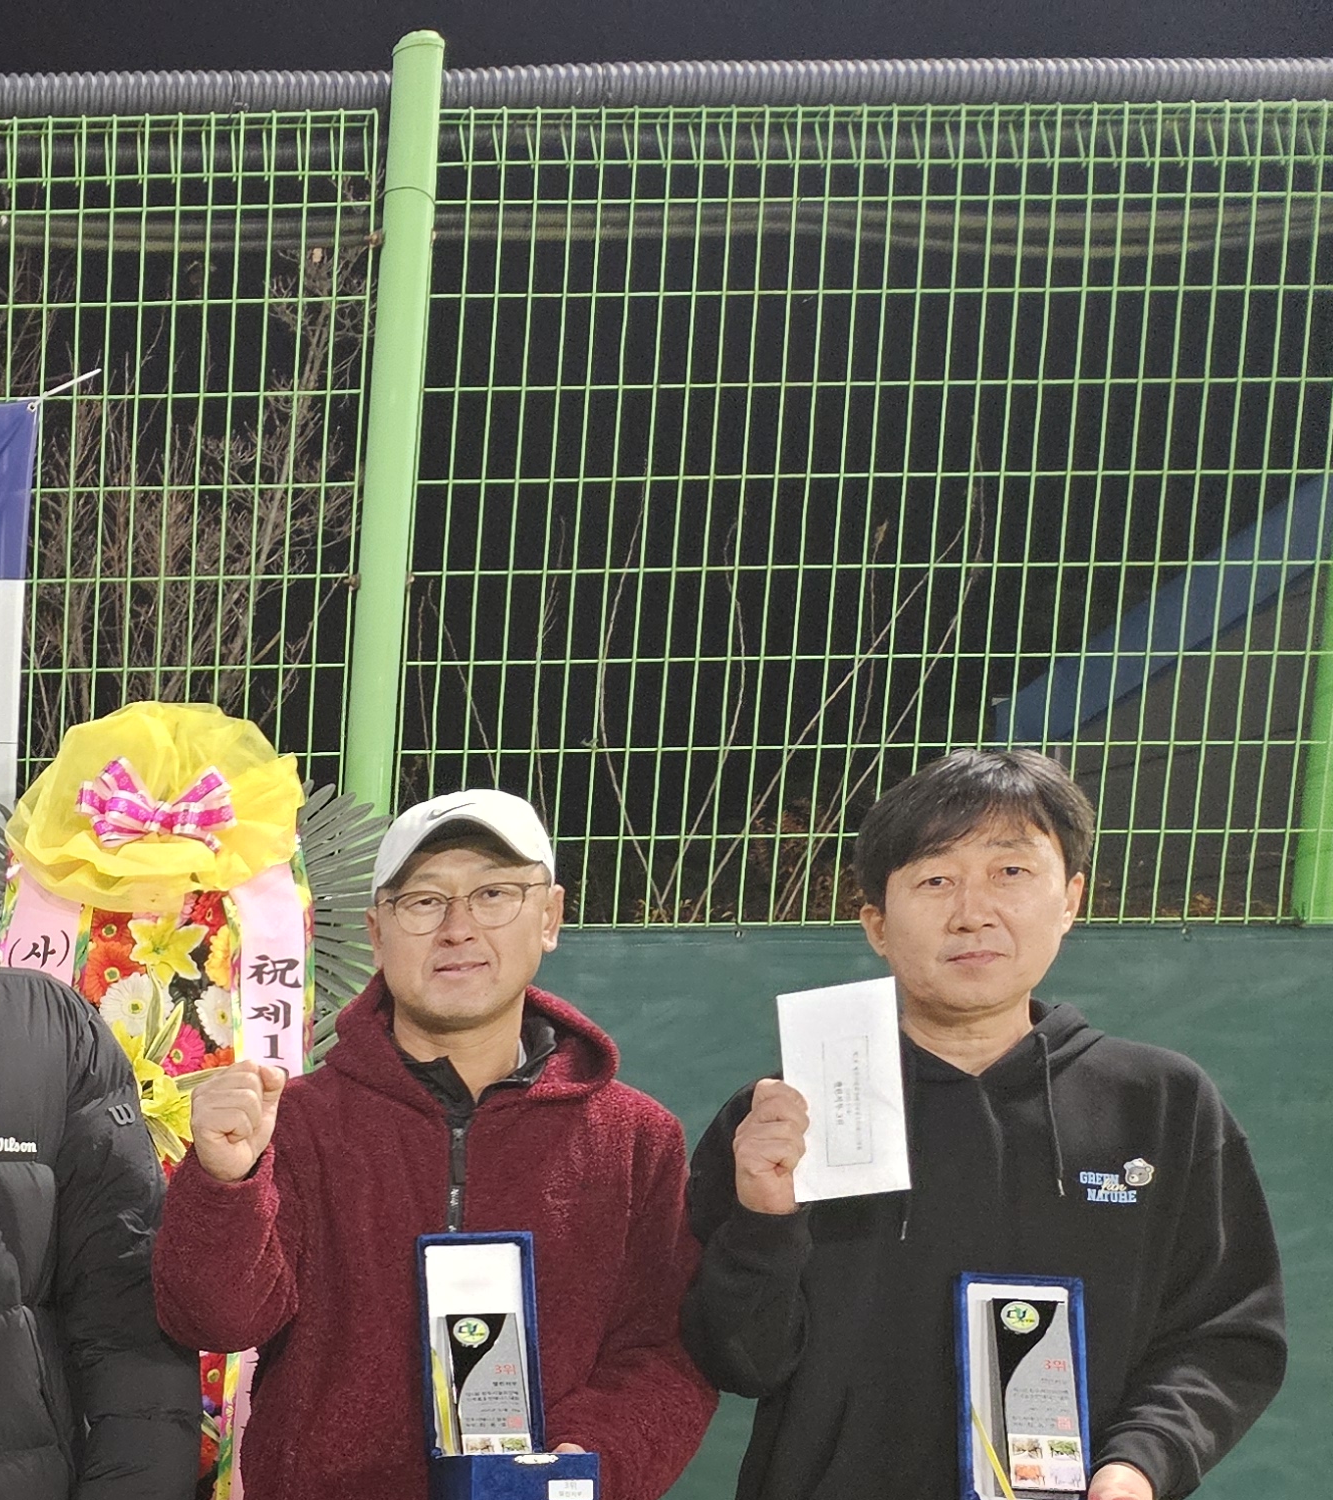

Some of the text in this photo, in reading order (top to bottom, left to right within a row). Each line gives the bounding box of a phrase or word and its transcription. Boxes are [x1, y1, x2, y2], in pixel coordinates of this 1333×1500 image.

[8, 930, 70, 969] (사)
[246, 954, 302, 1079] 祝 제1
[1079, 1171, 1119, 1186] GREEN
[1087, 1188, 1137, 1203] NATURE
[495, 1364, 516, 1375] 3위
[1044, 1360, 1066, 1372] 3위
